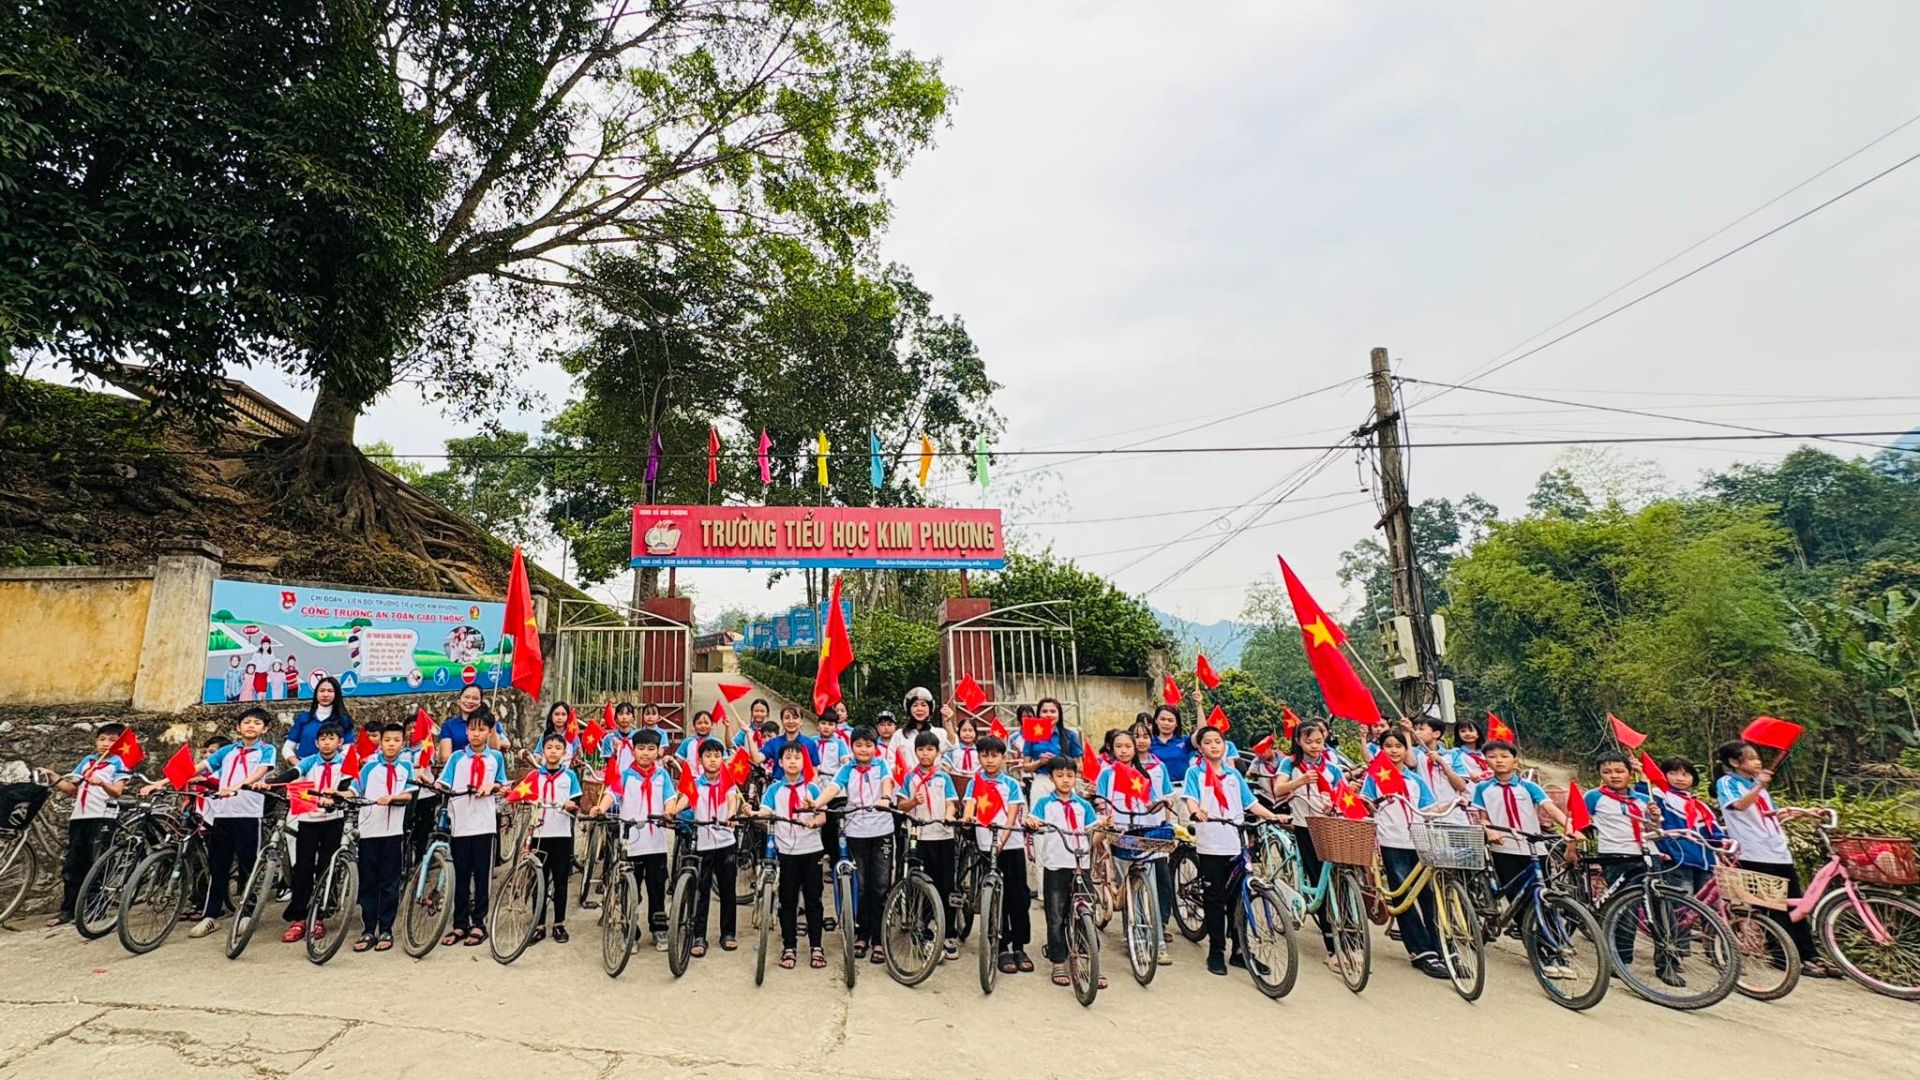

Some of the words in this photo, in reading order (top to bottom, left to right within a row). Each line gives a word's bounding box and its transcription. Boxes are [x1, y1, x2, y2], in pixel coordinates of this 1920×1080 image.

[701, 512, 776, 549] TRƯỜNG
[784, 510, 825, 549] TIỂU
[832, 520, 869, 556] HỌC
[877, 521, 913, 550] KIM
[920, 520, 994, 557] PHƯỢNG
[376, 610, 387, 619] AN
[417, 613, 436, 622] GIAO
